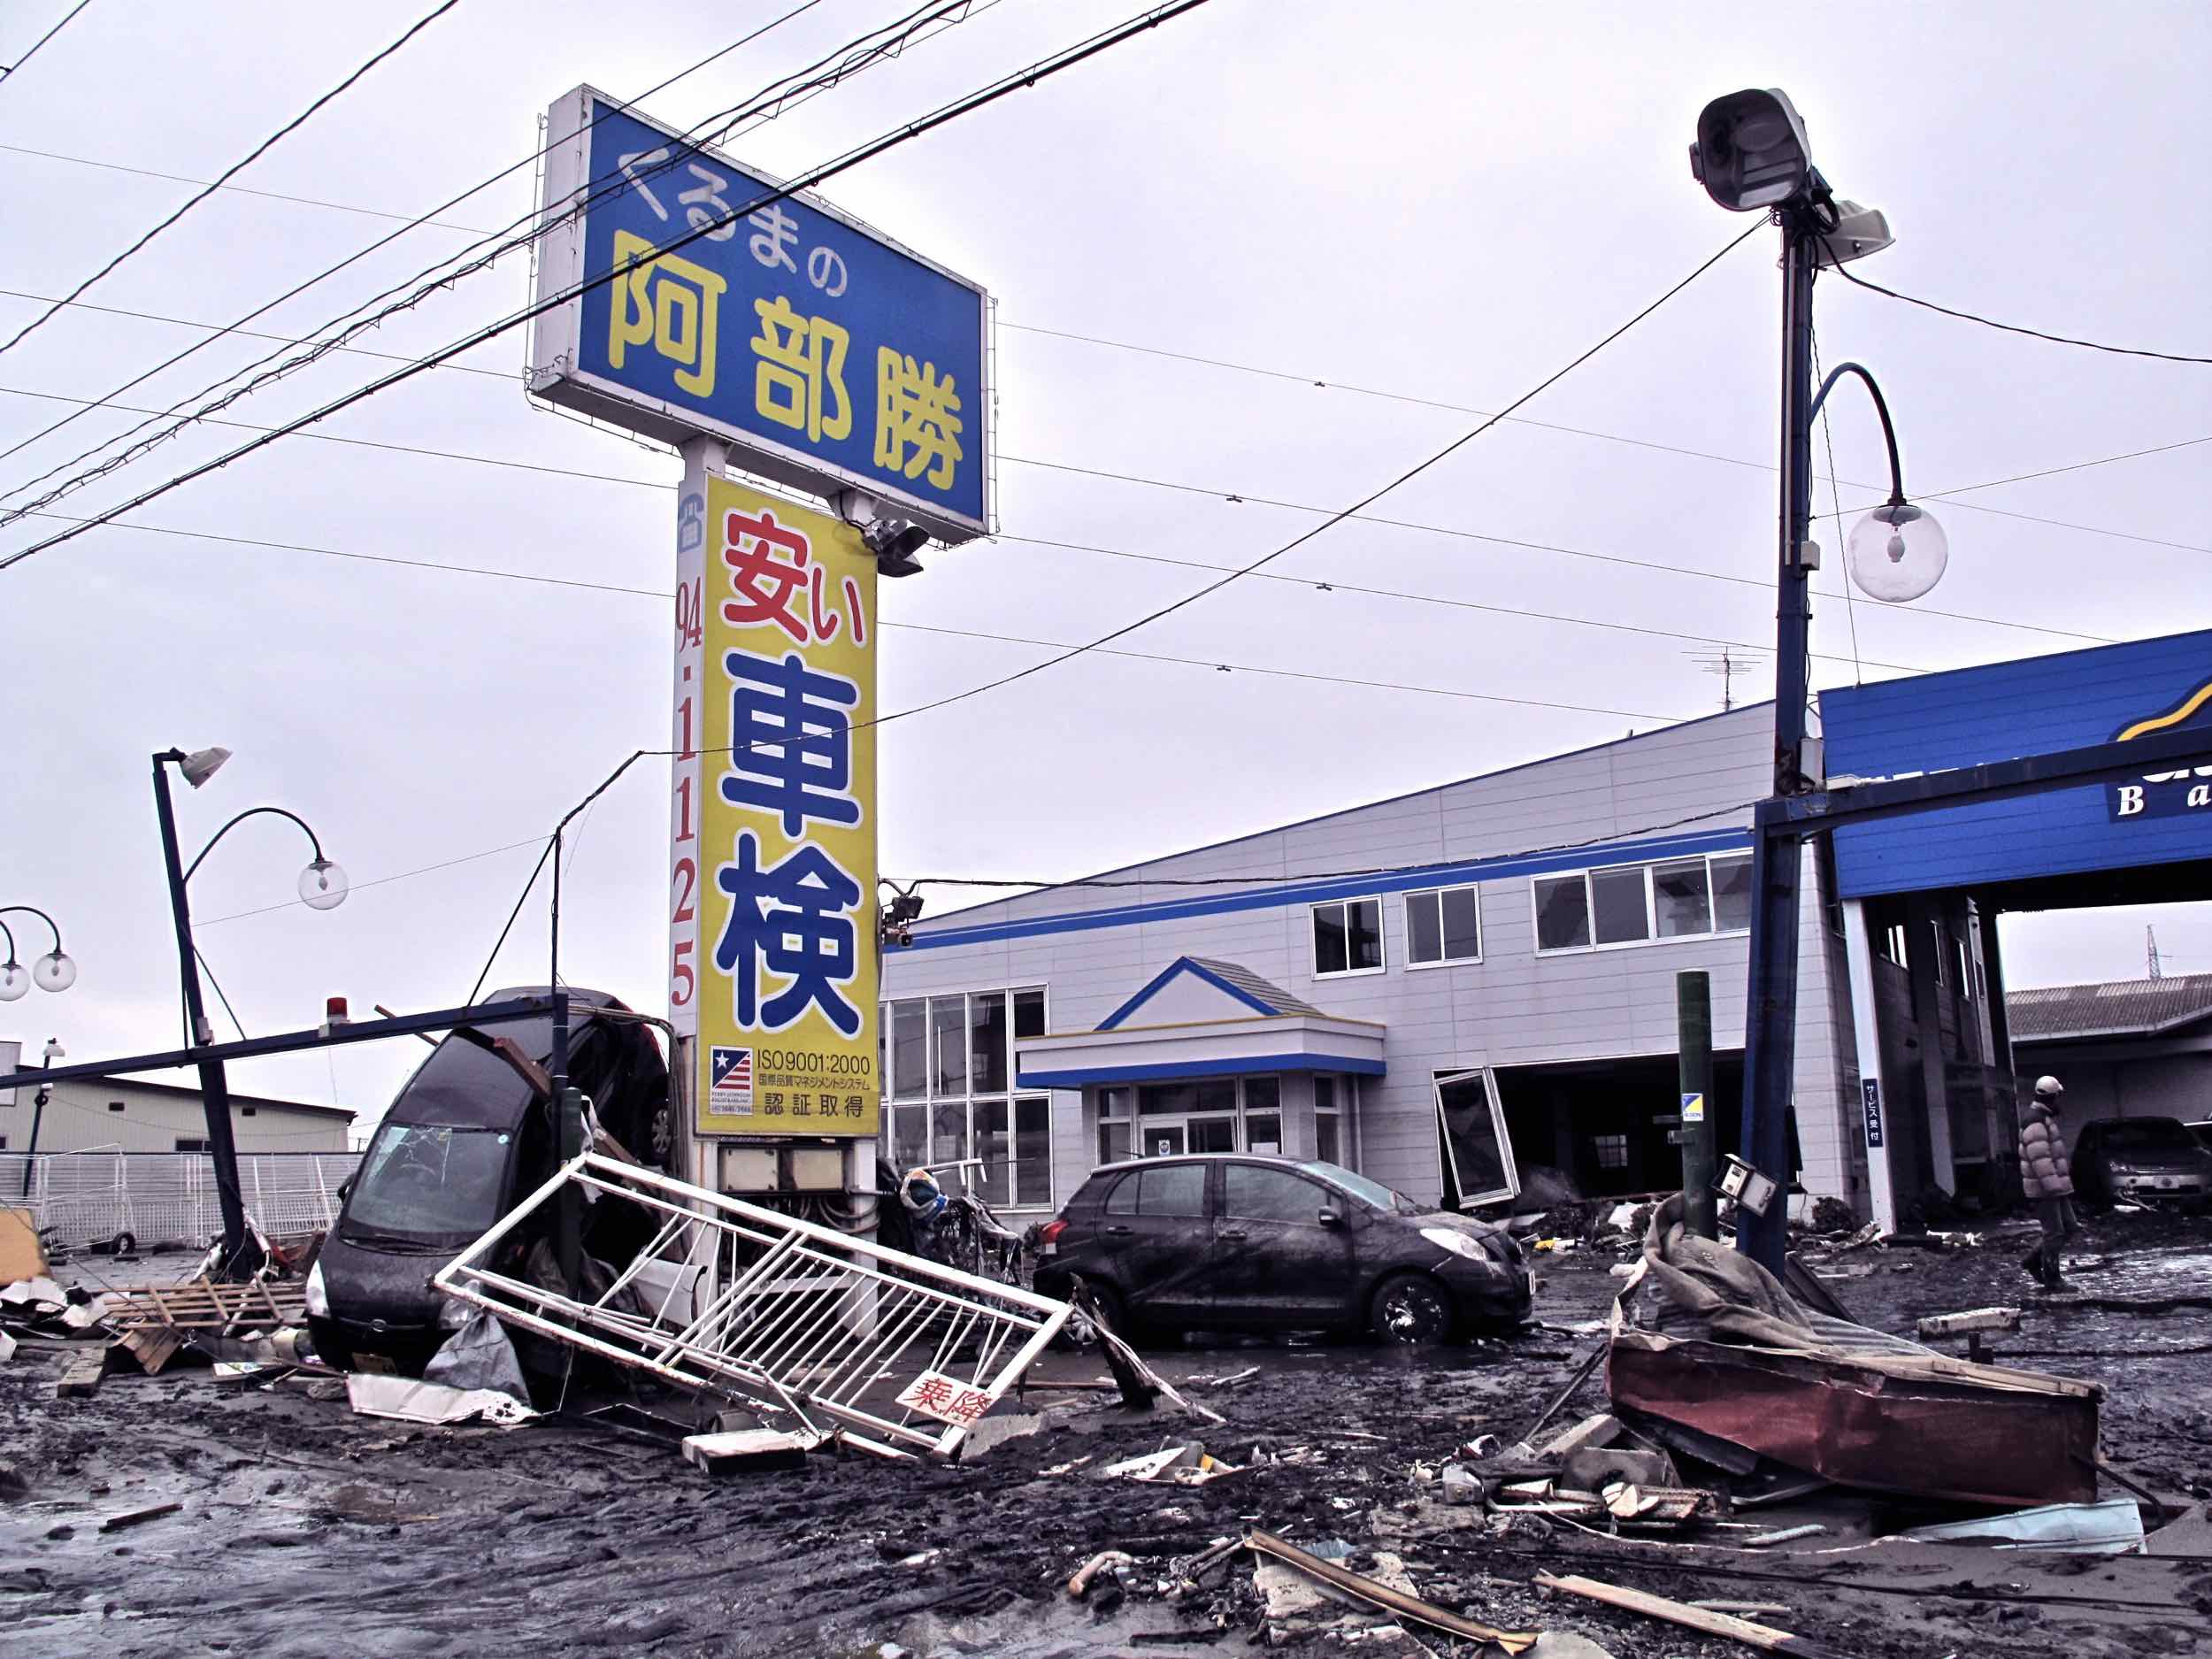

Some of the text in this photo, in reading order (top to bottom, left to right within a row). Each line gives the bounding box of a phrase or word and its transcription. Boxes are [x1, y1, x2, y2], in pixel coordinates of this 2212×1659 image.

[618, 147, 848, 297] くるまの
[608, 228, 964, 491] 阿部勝
[722, 511, 865, 644] 安い
[715, 651, 861, 1036] 車検
[764, 1092, 864, 1118] 認証取得
